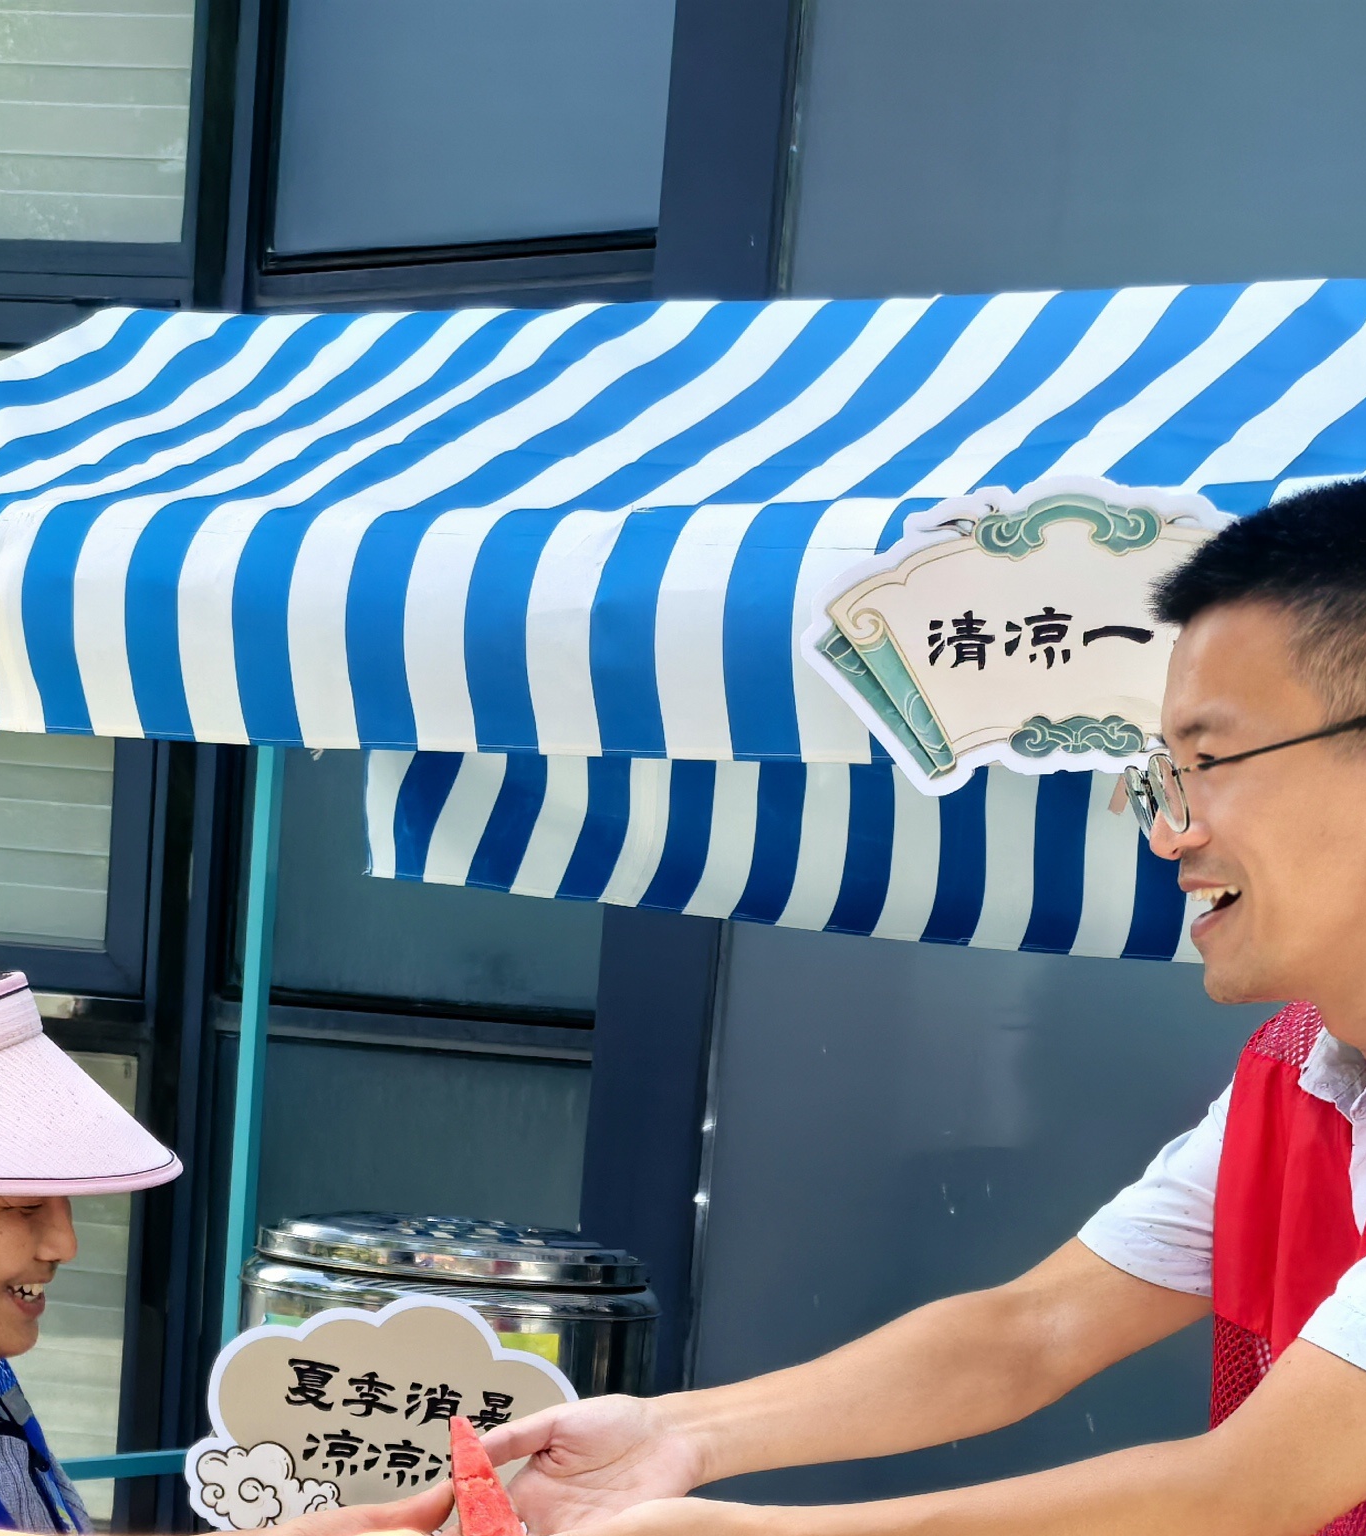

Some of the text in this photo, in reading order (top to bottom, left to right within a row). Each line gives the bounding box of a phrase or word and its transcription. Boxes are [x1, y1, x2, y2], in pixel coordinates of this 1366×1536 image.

[927, 606, 1154, 671] 清凉一
[302, 1429, 452, 1488] 凉凉
